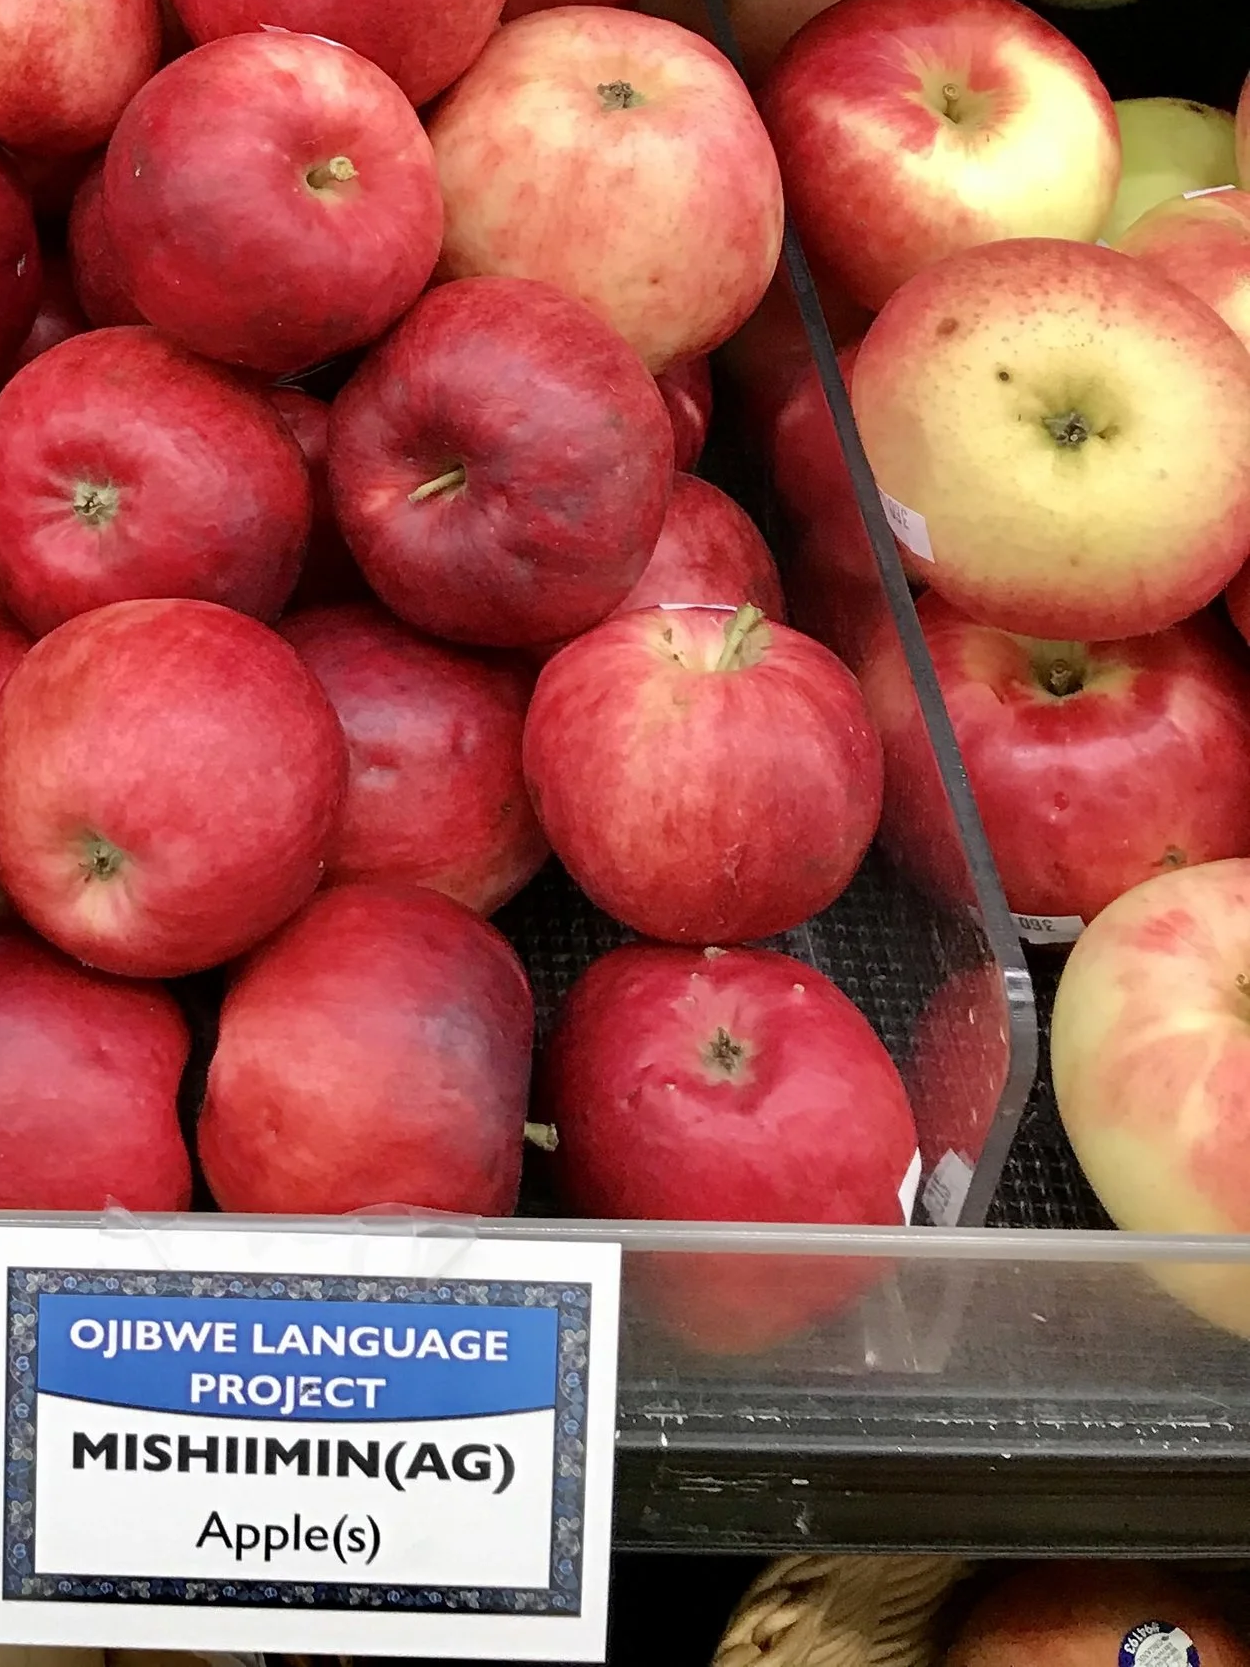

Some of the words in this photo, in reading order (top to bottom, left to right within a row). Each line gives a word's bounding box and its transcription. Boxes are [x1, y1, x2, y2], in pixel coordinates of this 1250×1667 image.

[1018, 917, 1056, 932] 360
[70, 1319, 237, 1359] OJIBWE
[253, 1324, 508, 1362] LANGUAGE
[190, 1373, 386, 1415] PROJECT
[72, 1431, 515, 1494] MISHIIMIN(AG)
[195, 1510, 380, 1565] Apple(s)
[1123, 1621, 1160, 1654] #94193
